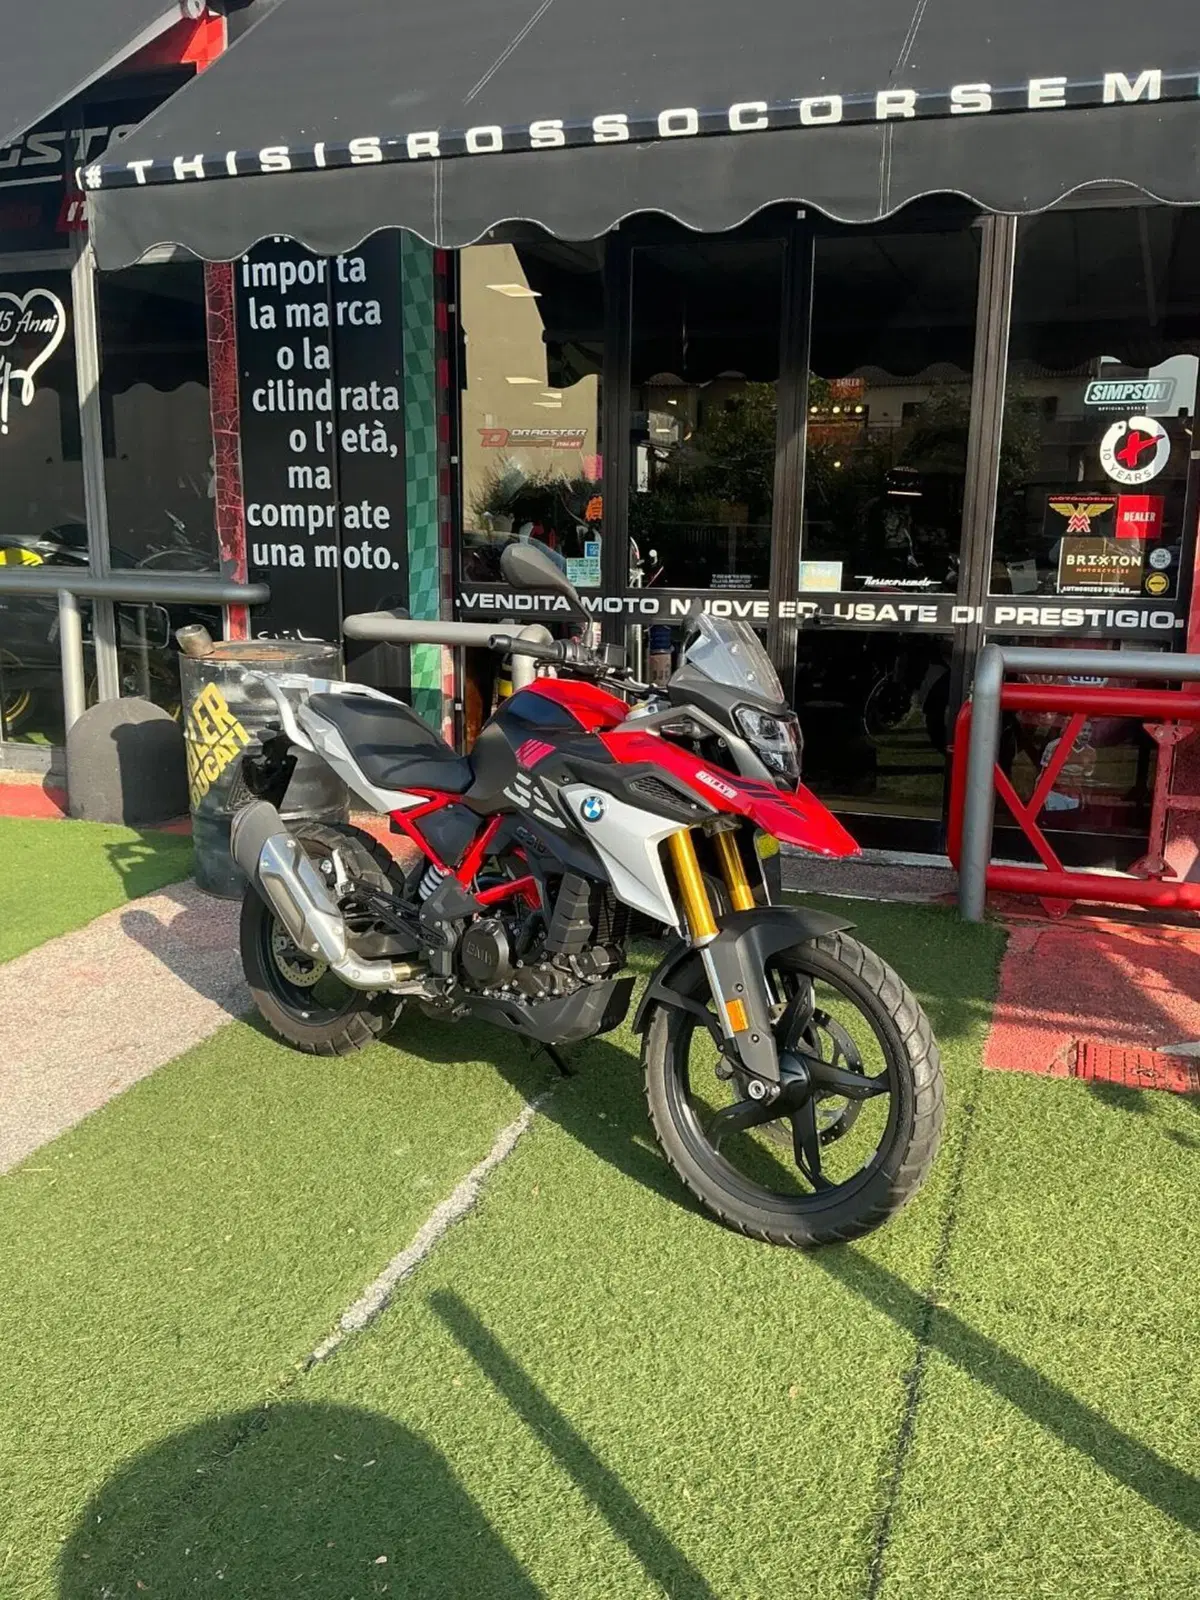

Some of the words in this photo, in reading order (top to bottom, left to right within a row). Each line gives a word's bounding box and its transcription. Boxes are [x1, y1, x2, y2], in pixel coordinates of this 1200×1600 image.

[242, 254, 367, 294] importa
[15, 310, 58, 333] Anni
[249, 297, 277, 329] la
[285, 300, 382, 328] marca
[276, 346, 294, 370] o
[303, 337, 330, 369] la
[252, 379, 400, 411] cilindrata
[1091, 383, 1167, 401] SIMPSON
[289, 429, 307, 452] o
[288, 465, 332, 489] ma
[1109, 463, 1151, 482] YEARS
[247, 501, 390, 535] comprate
[1123, 511, 1156, 522] DEALER
[252, 542, 306, 568] una
[314, 541, 400, 571] moto.
[1066, 554, 1142, 567] BRIXTON
[581, 598, 660, 614] MOTO
[834, 603, 937, 622] USATE
[951, 606, 983, 624] DI
